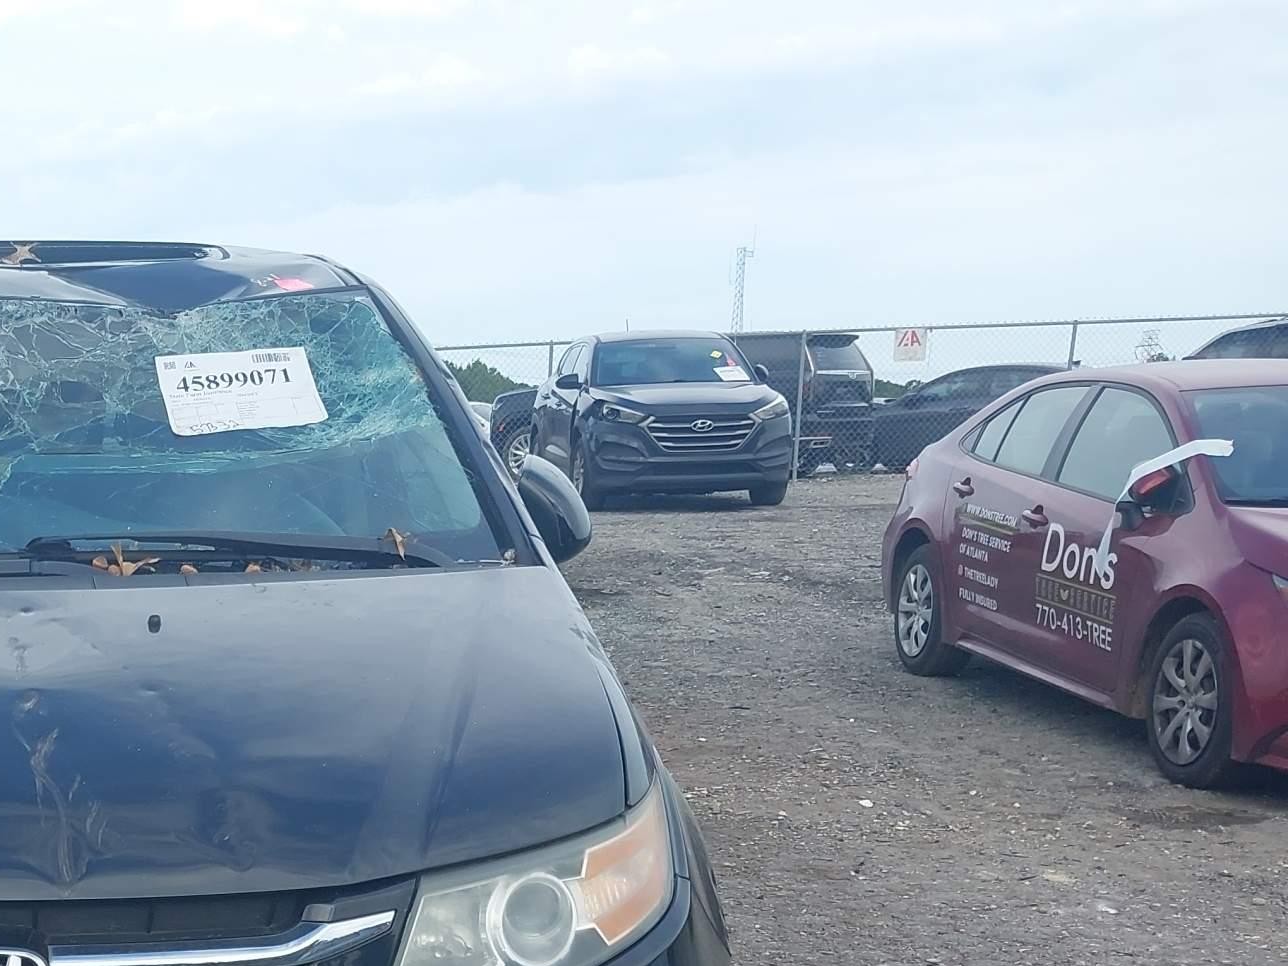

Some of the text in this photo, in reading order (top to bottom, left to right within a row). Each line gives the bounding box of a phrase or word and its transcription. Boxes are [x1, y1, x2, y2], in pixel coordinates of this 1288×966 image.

[176, 367, 294, 393] 45899071
[966, 502, 1018, 528] WWW.DONSTREE.COM
[959, 543, 989, 562] OF ATLANTA
[978, 531, 989, 546] TREE
[989, 536, 1012, 553] SERVICE
[958, 587, 998, 611] FULLY INSURED
[1035, 603, 1113, 652] 770-413-TREE
